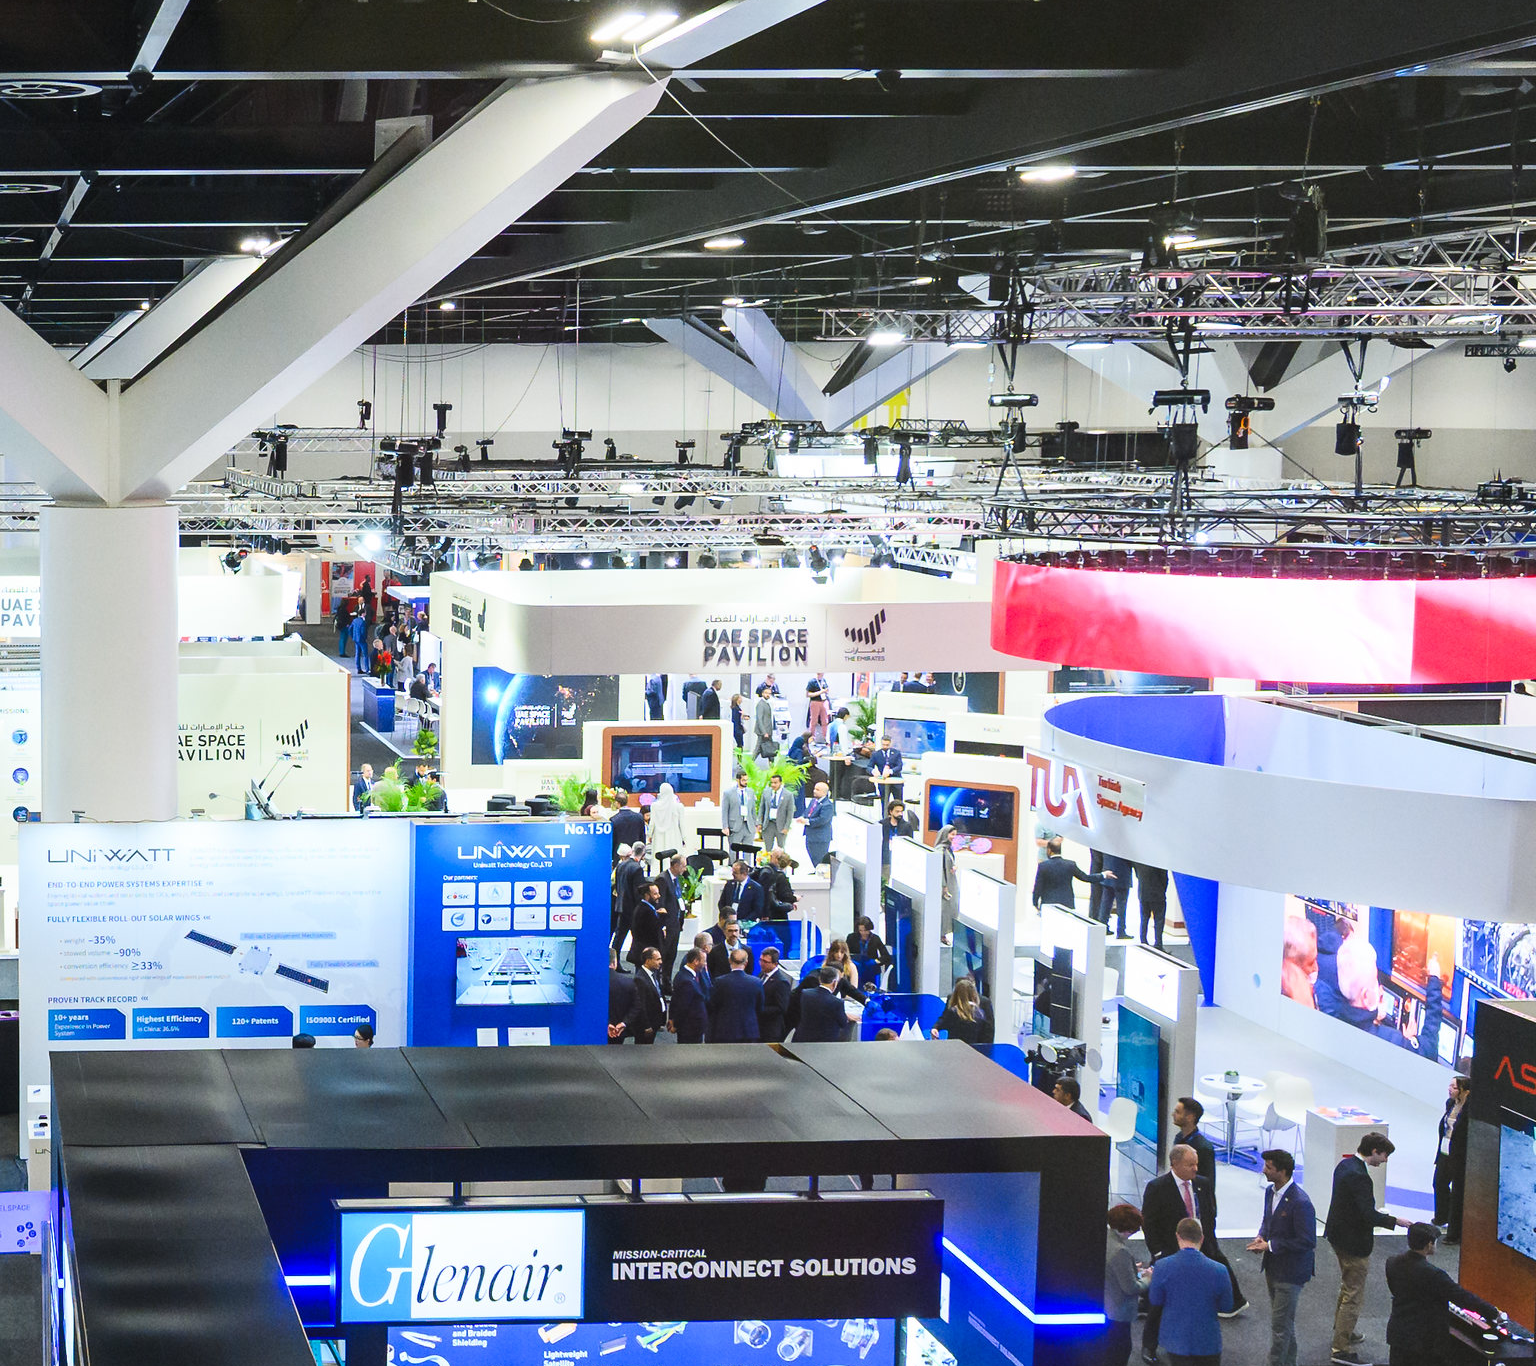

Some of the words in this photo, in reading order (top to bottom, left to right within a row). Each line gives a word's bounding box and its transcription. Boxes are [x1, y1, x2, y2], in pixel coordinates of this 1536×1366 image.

[1, 598, 33, 612] UAE
[704, 629, 742, 645] UAE
[748, 629, 808, 645] SPACE
[703, 646, 808, 667] PAVILION
[565, 824, 612, 835] No.150
[97, 880, 125, 888] POWER
[127, 880, 160, 888] SYSTEMS
[162, 880, 202, 888] EXPERTISE
[48, 996, 74, 1004] PROVEN
[104, 995, 138, 1003] RECORD
[137, 1015, 162, 1024] Highest
[164, 1014, 203, 1024] Efficiency
[306, 1016, 335, 1024] ISO9001
[337, 1015, 370, 1023] Certified
[612, 1248, 708, 1261] MISSION-CRITICAL
[349, 1222, 563, 1309] Glenair
[612, 1260, 782, 1281] INTERCONNECT
[789, 1256, 917, 1277] SOLUTIONS
[452, 1339, 487, 1348] Shielding
[544, 1350, 588, 1360] Lightweight
